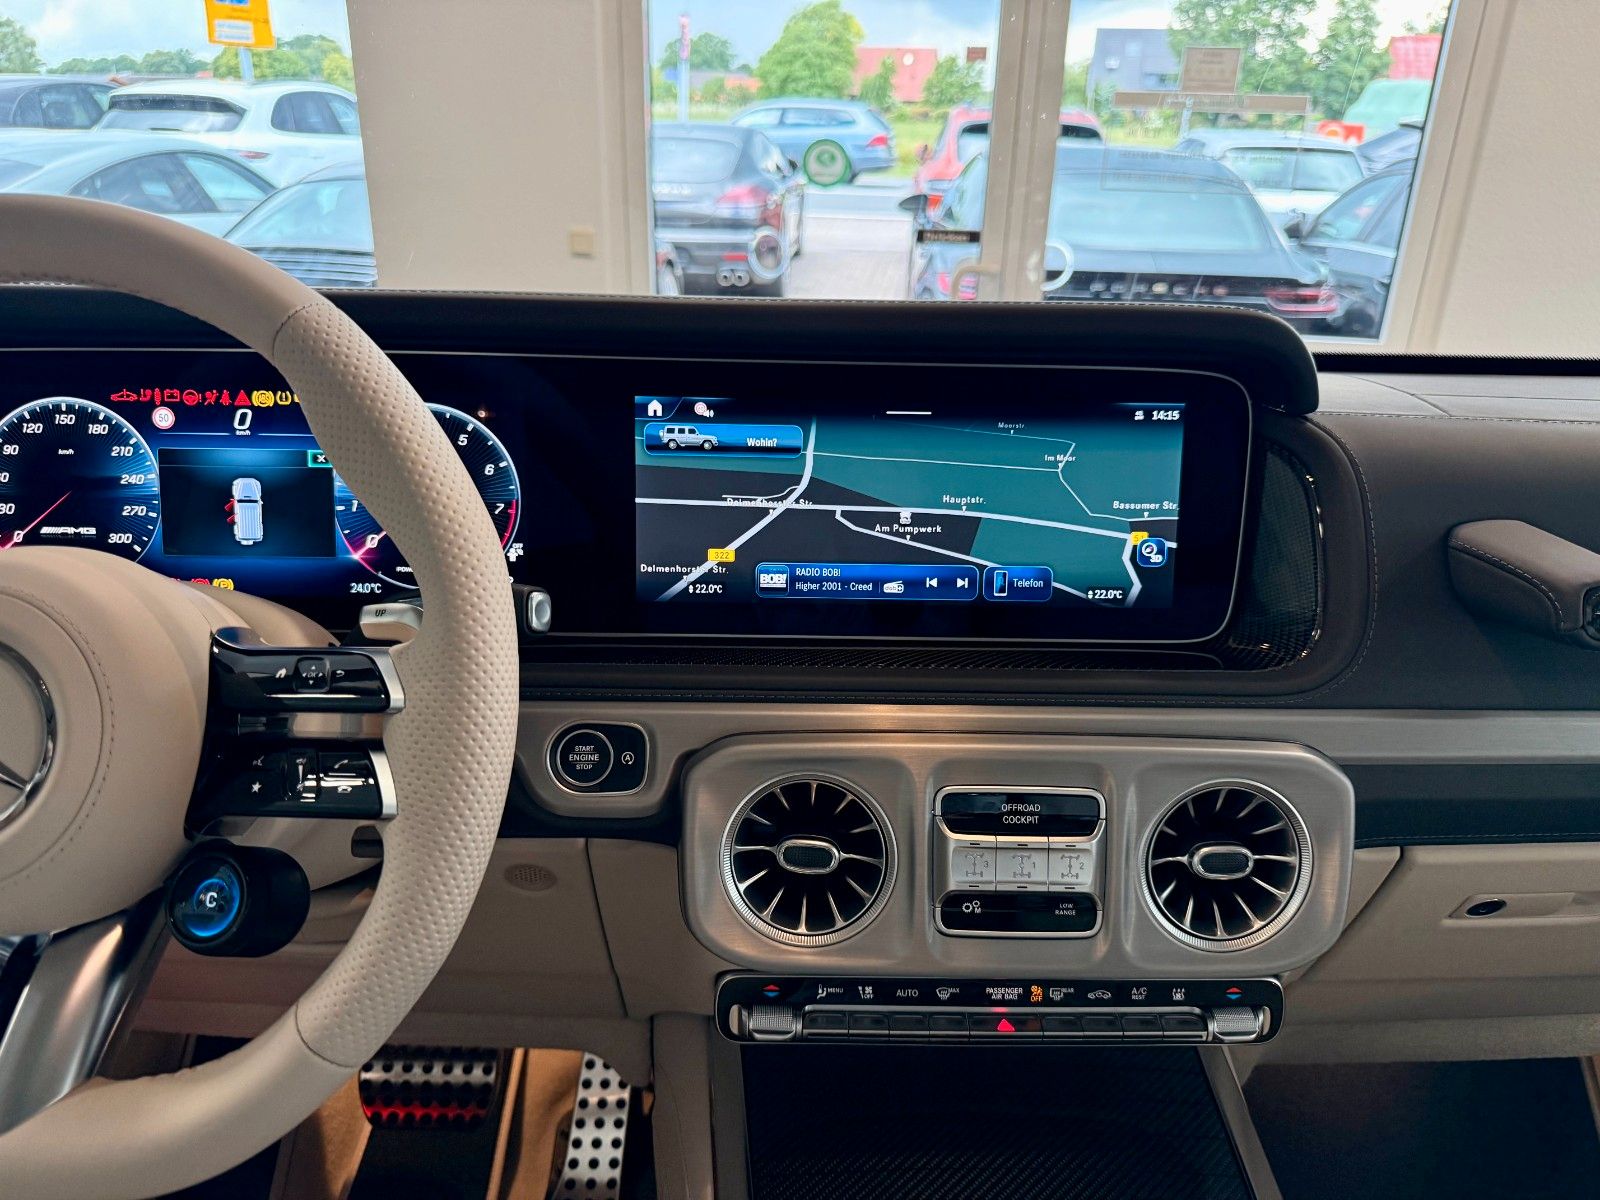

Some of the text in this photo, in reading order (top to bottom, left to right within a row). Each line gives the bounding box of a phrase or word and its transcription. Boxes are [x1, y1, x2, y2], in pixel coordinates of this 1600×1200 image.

[54, 414, 75, 425] 150
[158, 414, 169, 423] 50
[233, 409, 252, 430] 0
[1151, 410, 1180, 420] 14:15
[22, 423, 43, 434] 120
[88, 424, 109, 435] 180
[457, 434, 469, 446] 5
[746, 437, 777, 448] Wohin?
[3, 444, 19, 455] 90
[58, 448, 74, 456] km/h
[111, 446, 133, 457] 210
[1056, 454, 1076, 462] Moor
[484, 464, 495, 475] 6
[0, 472, 9, 482] 0
[120, 474, 144, 485] 240
[942, 494, 987, 505] Hauptstr.
[351, 500, 359, 511] 1
[494, 503, 505, 514] 7
[1112, 500, 1180, 510] Bassumer Str.
[122, 506, 146, 516] 270
[874, 524, 942, 535] Am Pumpwerk
[13, 531, 24, 542] 0
[108, 533, 132, 544] 300
[366, 534, 379, 547] 0
[714, 551, 730, 560] 322
[1150, 554, 1163, 562] 3D
[712, 565, 729, 574] Str.
[795, 567, 841, 577] RADIO BOB!
[760, 573, 787, 584] BOB!
[1012, 578, 1044, 588] Telefon
[350, 583, 382, 593] 24.0°C
[695, 584, 723, 594] 22.0°C
[795, 581, 820, 592] Higher
[822, 582, 842, 591] 2001
[849, 582, 873, 591] Creed
[1094, 590, 1122, 599] 22.0°C
[374, 609, 387, 617] UP
[569, 753, 600, 761] ENGINE
[1001, 803, 1041, 812] OFFROAD
[1002, 815, 1040, 824] COCKPIT
[1079, 862, 1085, 870] 2
[205, 892, 218, 908] C
[896, 988, 919, 997] AUTO
[1131, 986, 1148, 995] A/C
